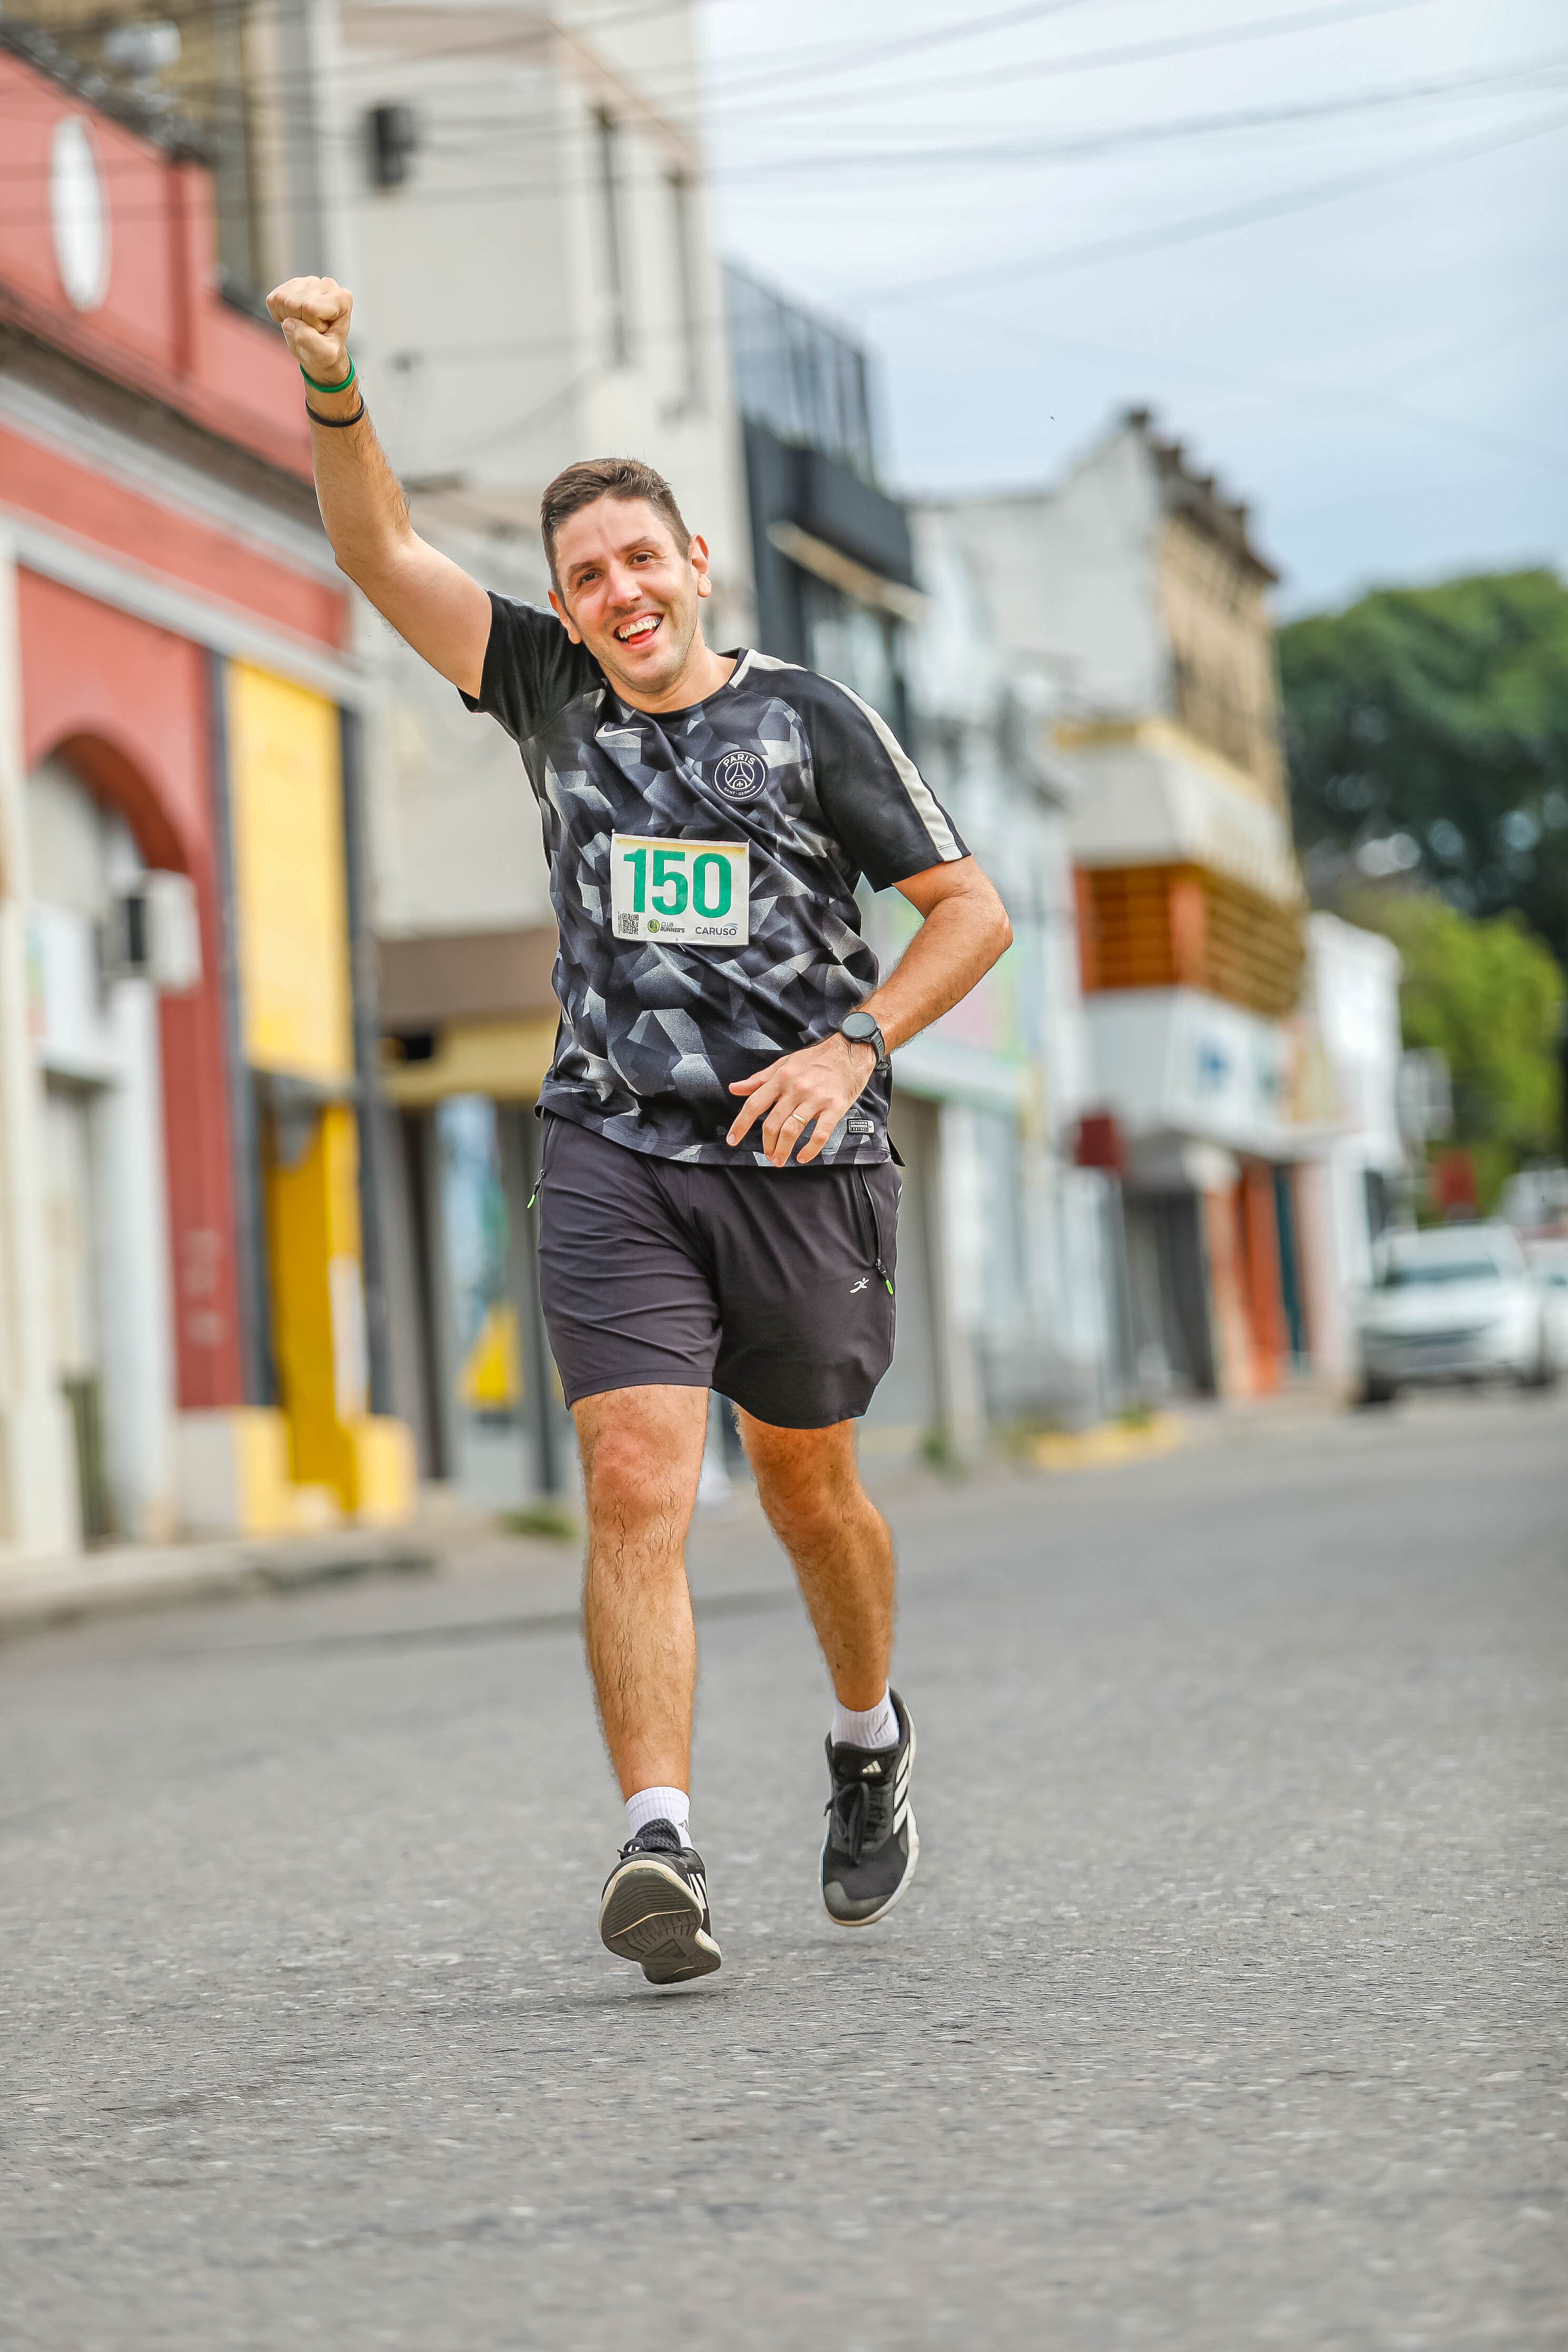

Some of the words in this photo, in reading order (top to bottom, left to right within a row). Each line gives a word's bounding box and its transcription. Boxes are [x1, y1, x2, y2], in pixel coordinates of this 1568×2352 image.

[723, 753, 756, 767] PARIS
[623, 848, 731, 918] 150
[695, 926, 737, 936] CARUSO
